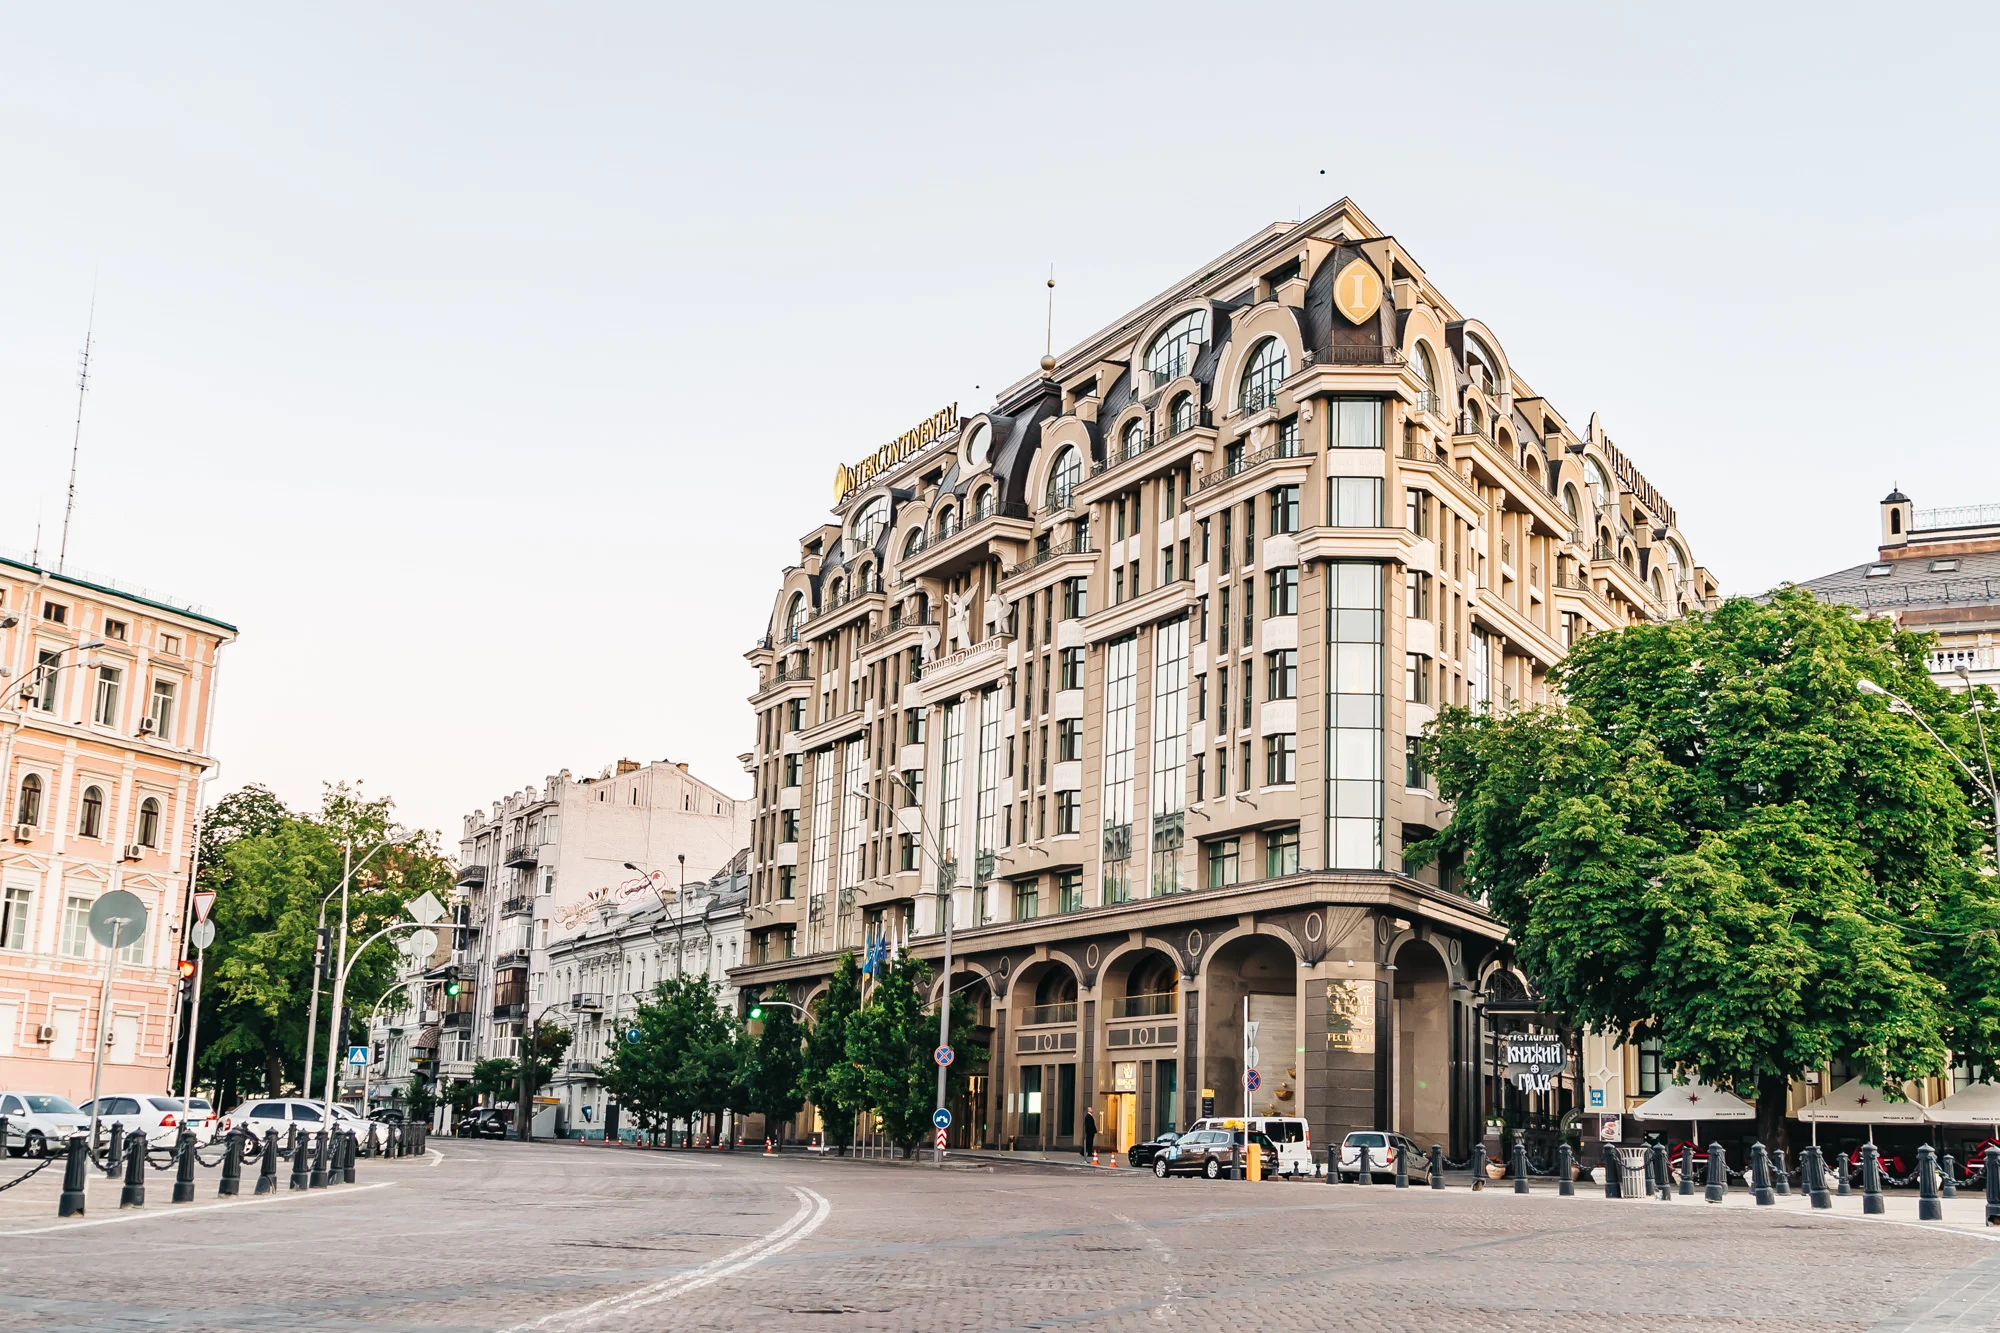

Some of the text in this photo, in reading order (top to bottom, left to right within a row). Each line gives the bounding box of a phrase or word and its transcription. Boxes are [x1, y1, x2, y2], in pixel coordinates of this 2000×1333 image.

[1347, 274, 1369, 309] I
[845, 401, 959, 492] INTERCONTINENTAL
[1600, 428, 1678, 528] INTERCONTINENTA
[1507, 1043, 1561, 1064] КНЯЖИЙ
